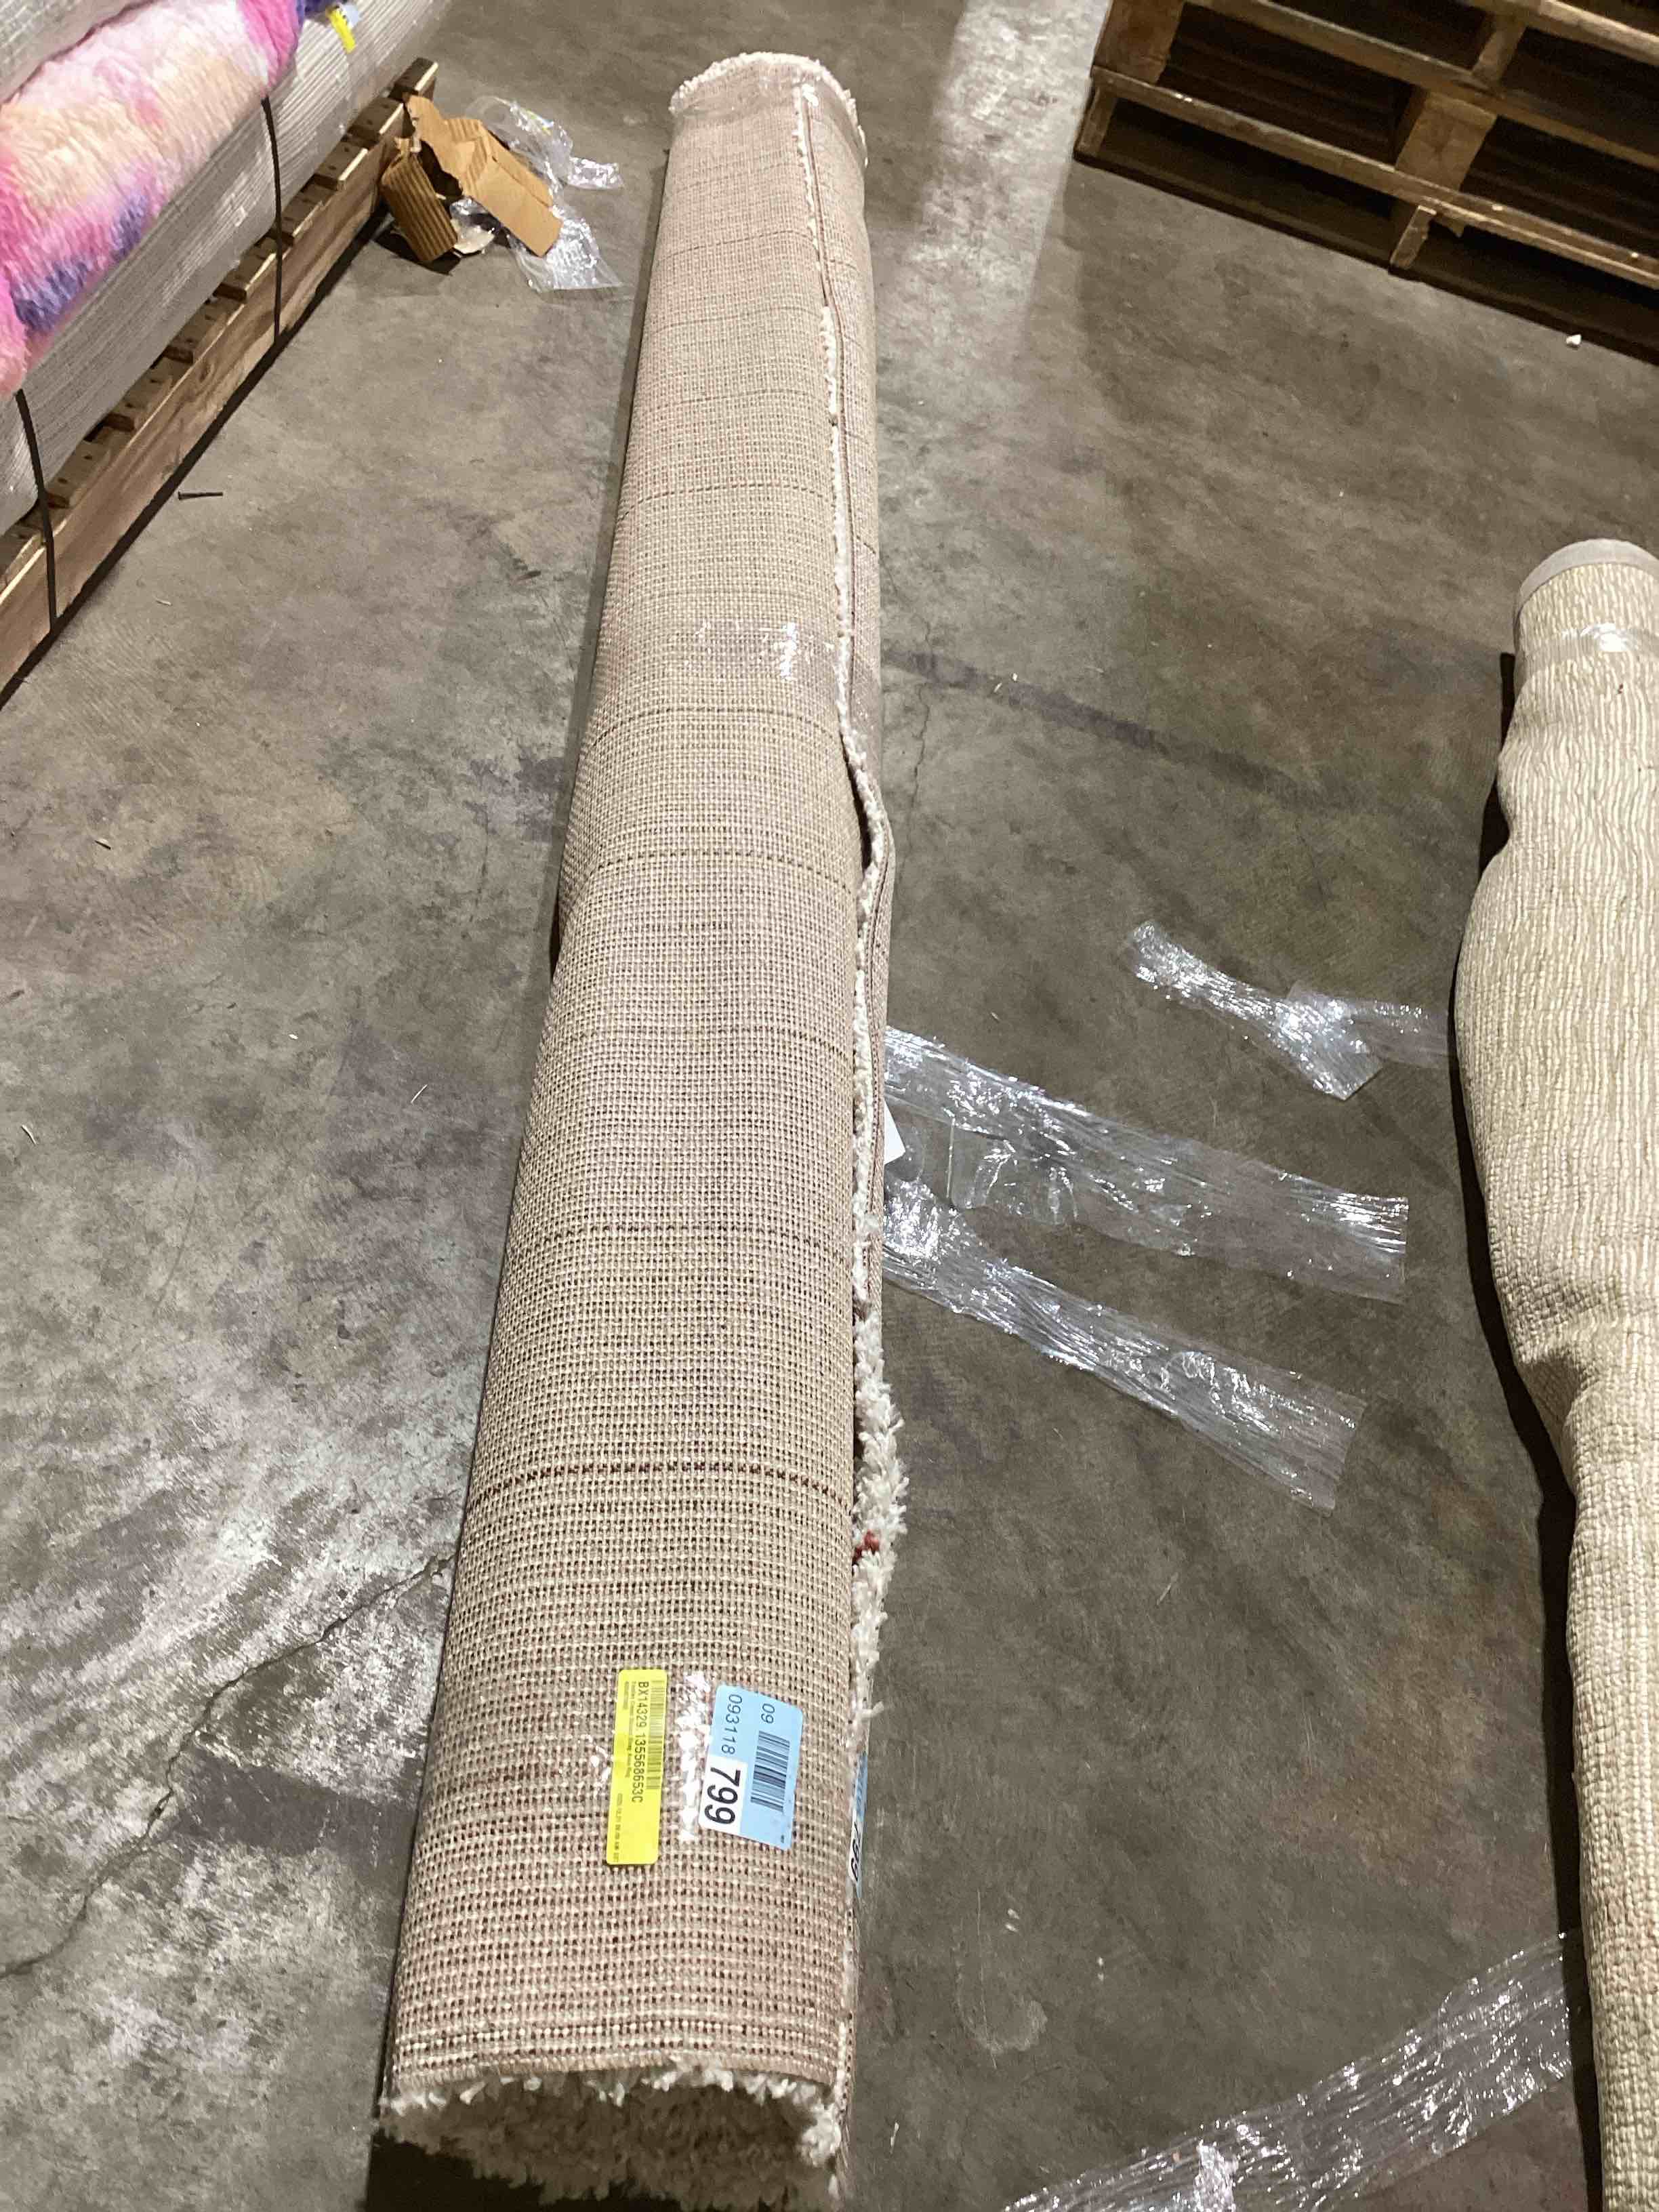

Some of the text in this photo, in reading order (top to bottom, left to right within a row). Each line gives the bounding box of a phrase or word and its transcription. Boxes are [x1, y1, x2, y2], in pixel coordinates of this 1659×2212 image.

[721, 1694, 743, 1755] 093118
[760, 1702, 775, 1724] 09
[704, 1766, 741, 1824] 799
